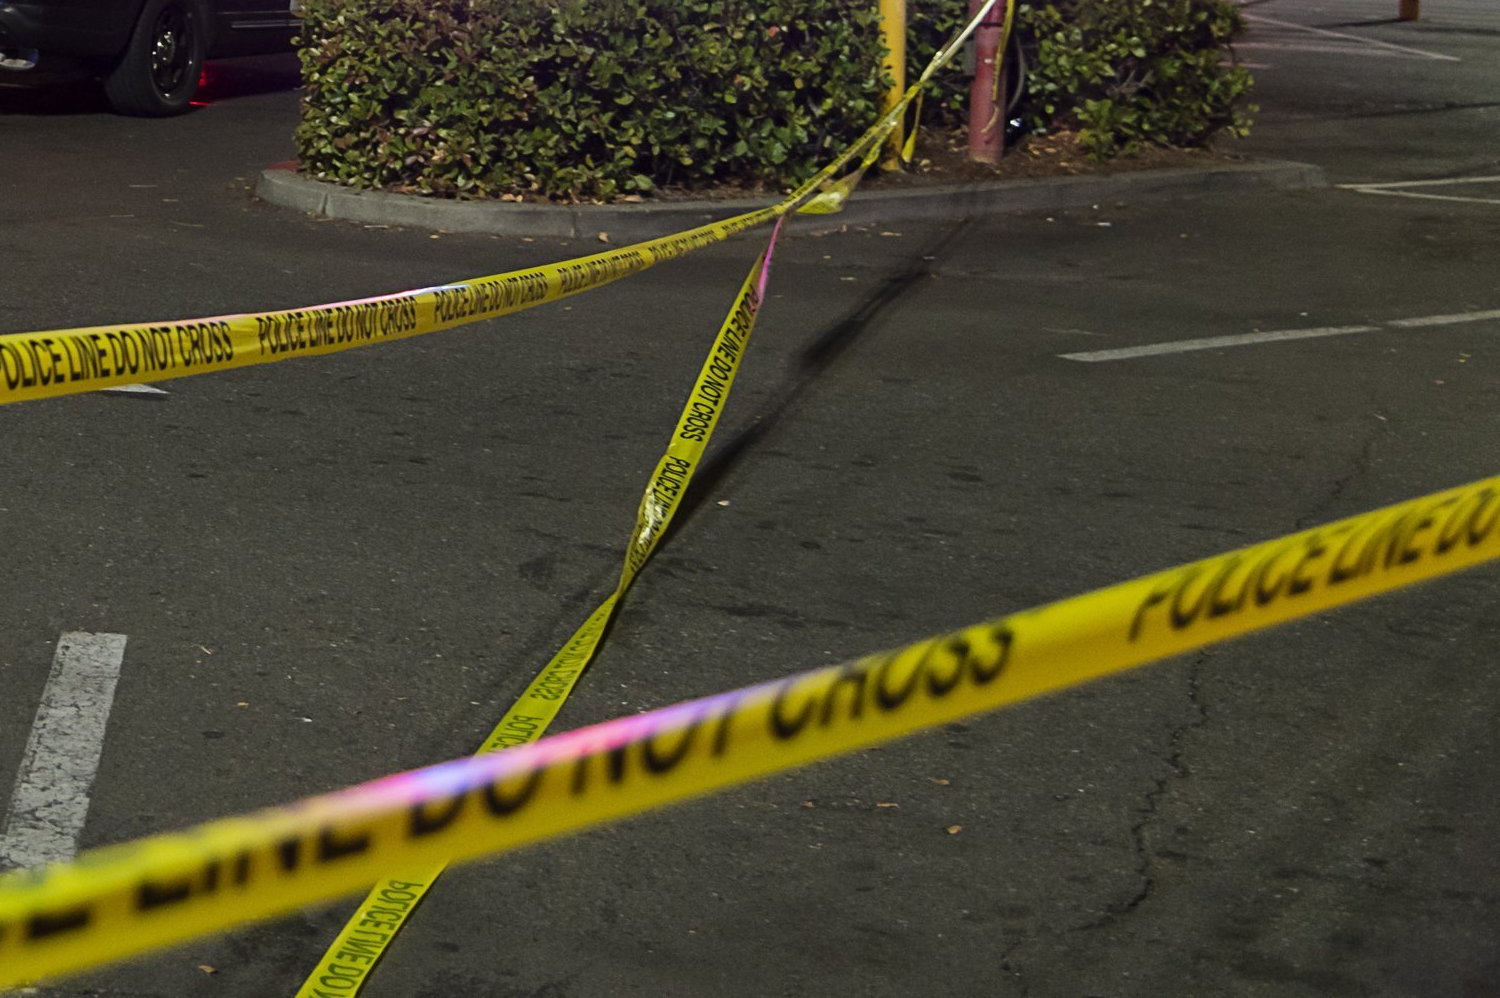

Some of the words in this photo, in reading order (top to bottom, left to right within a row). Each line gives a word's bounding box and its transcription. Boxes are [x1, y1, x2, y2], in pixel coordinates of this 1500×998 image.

[254, 312, 307, 356] POLICE
[302, 307, 336, 347] LINE
[332, 304, 356, 343] DO
[352, 300, 380, 340] NOT
[376, 295, 418, 335] CROSS
[730, 284, 760, 338] POLICE
[57, 333, 111, 382] LINE
[103, 330, 141, 377] DO
[137, 325, 179, 373] NOT
[179, 321, 236, 365] CROSS
[717, 324, 742, 365] LINE
[698, 371, 725, 407] NOT
[708, 357, 732, 383] DO
[680, 396, 717, 443] CROSS
[1128, 533, 1328, 643] POLICE
